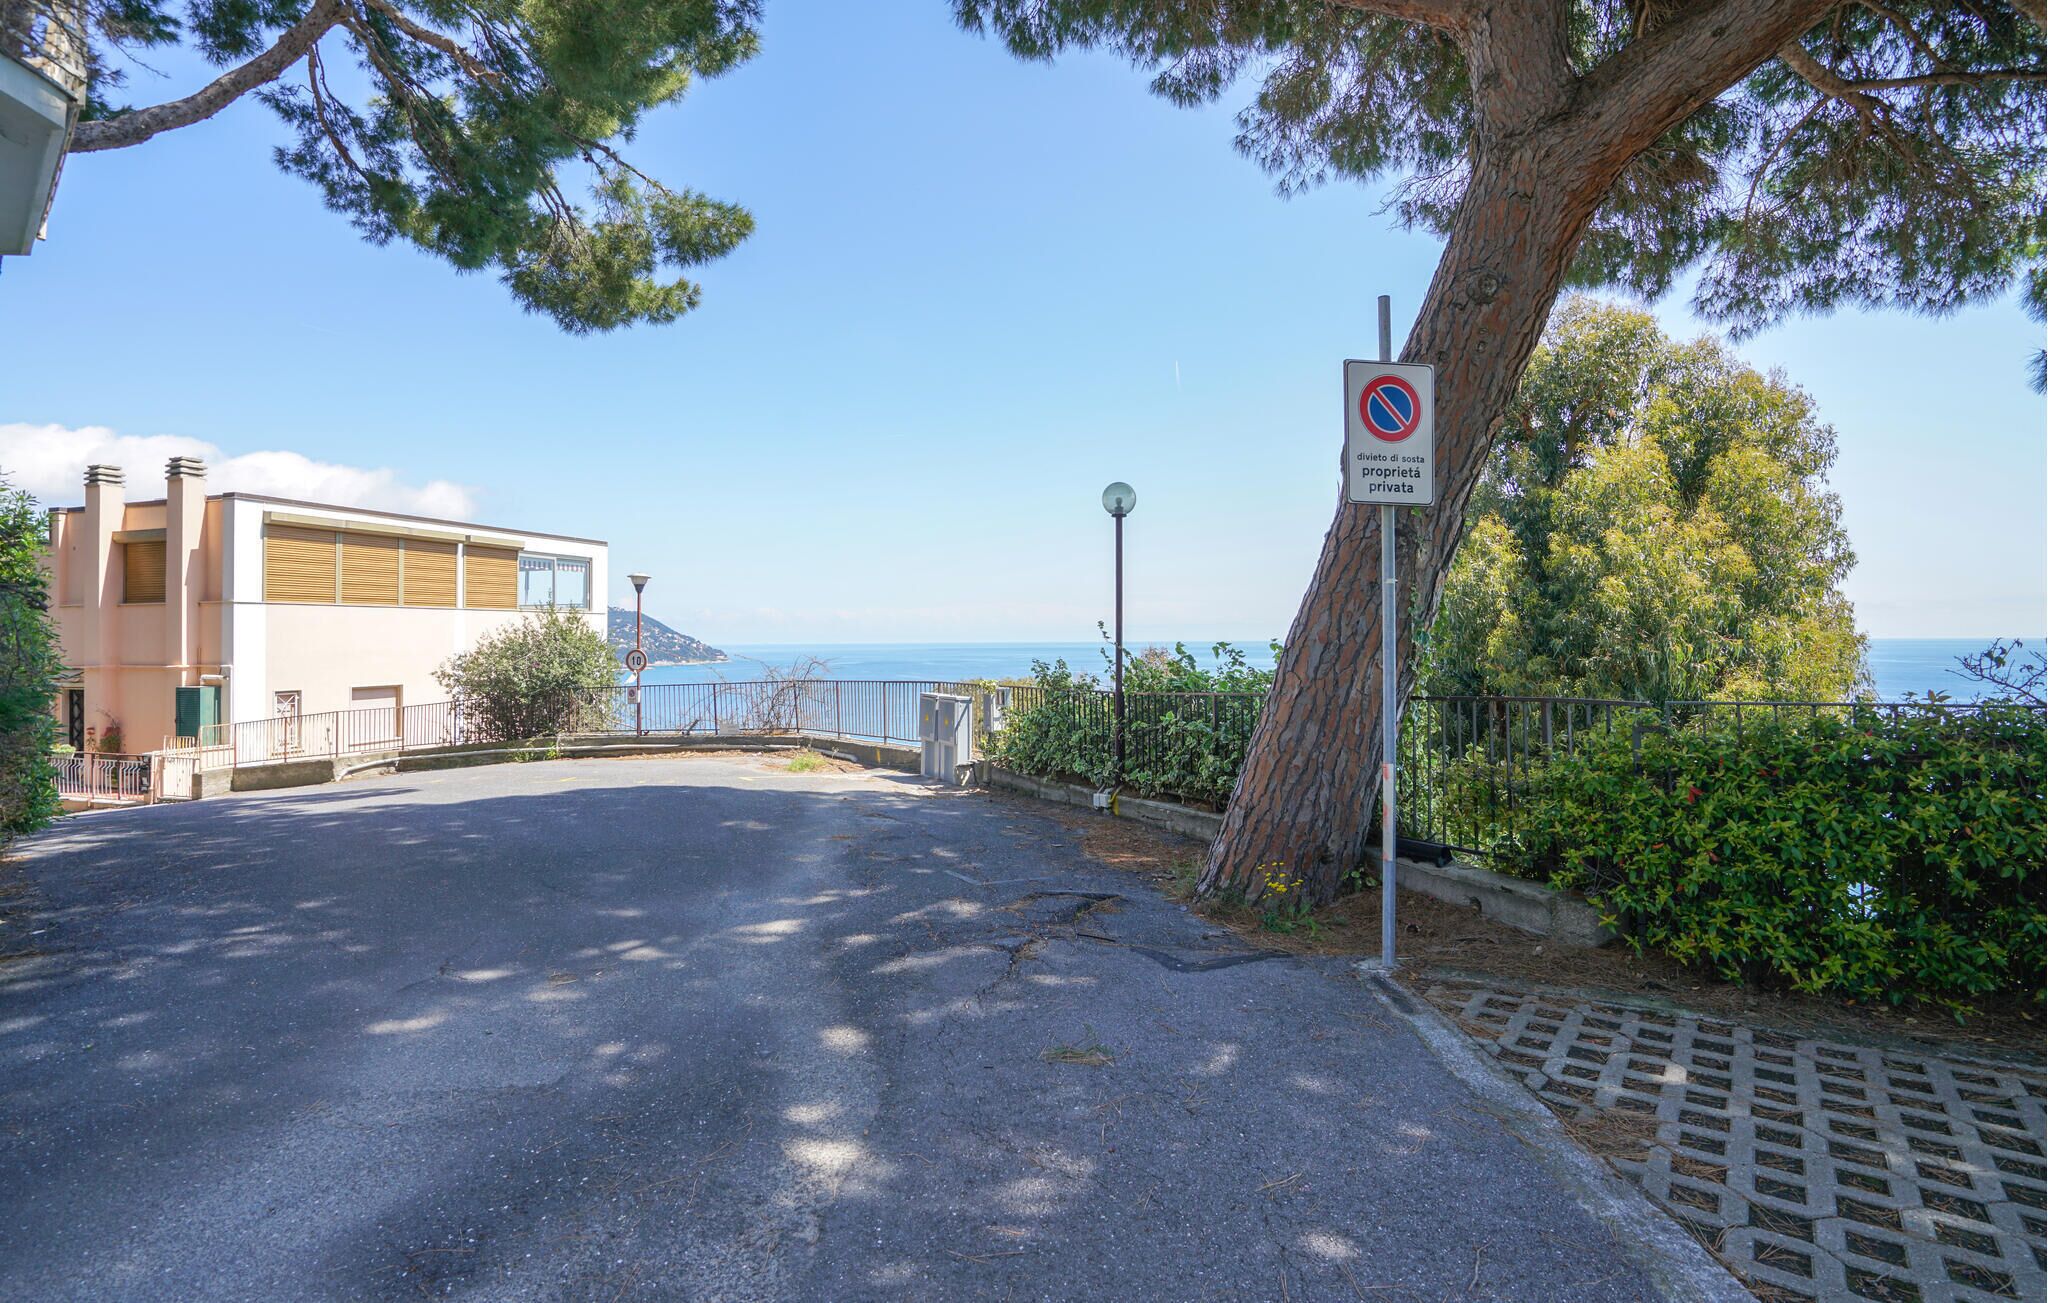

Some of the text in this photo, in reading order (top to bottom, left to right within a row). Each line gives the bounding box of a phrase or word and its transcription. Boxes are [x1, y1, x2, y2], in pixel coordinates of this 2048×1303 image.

[1356, 452, 1425, 464] divieto di sosta
[1369, 480, 1414, 494] privata
[631, 655, 642, 666] 10
